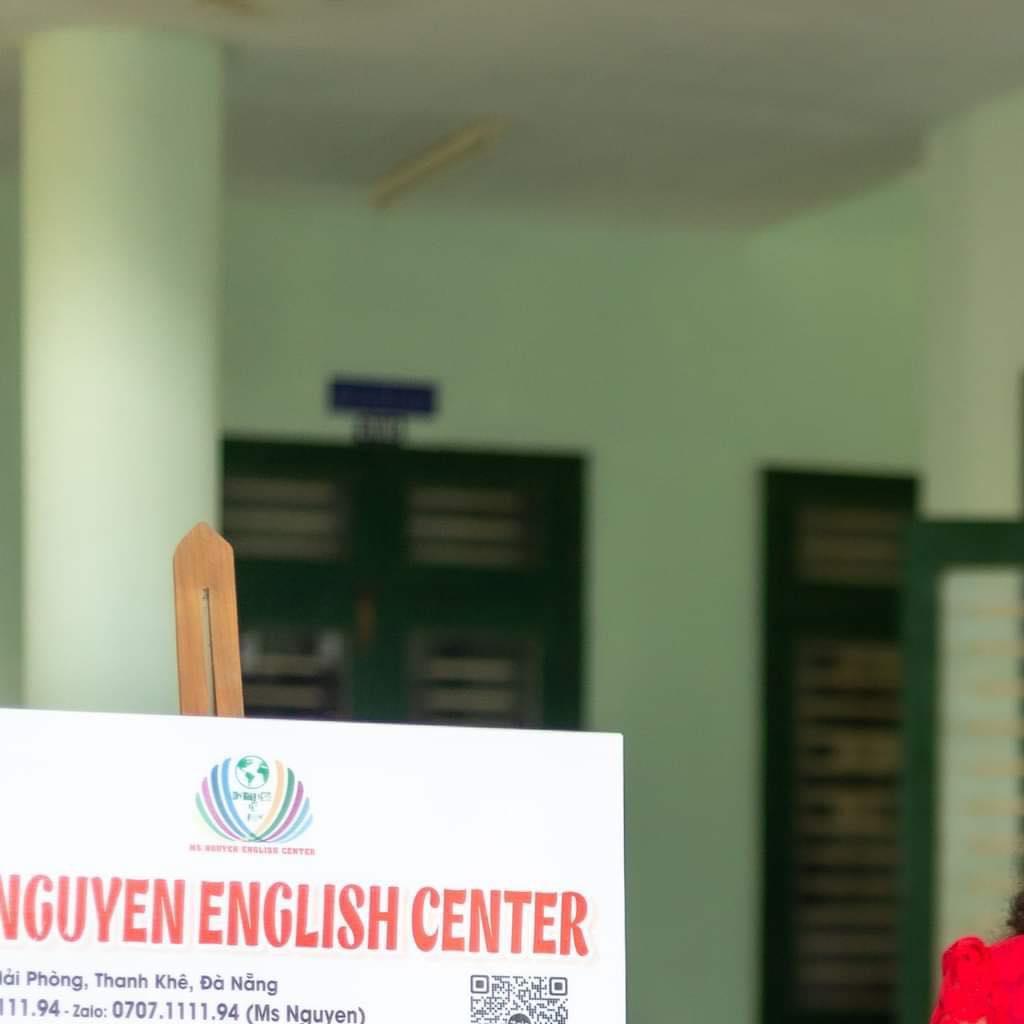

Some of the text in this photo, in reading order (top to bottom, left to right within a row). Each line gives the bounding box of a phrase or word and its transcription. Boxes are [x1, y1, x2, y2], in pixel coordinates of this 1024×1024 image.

[199, 880, 399, 950] ENGLISH
[411, 886, 589, 957] CENTER
[27, 970, 278, 996] Phòng, Thanh Khê, Đà Nẵng
[73, 1005, 107, 1018] Zalo:
[113, 1001, 239, 1021] 0707.1111.94
